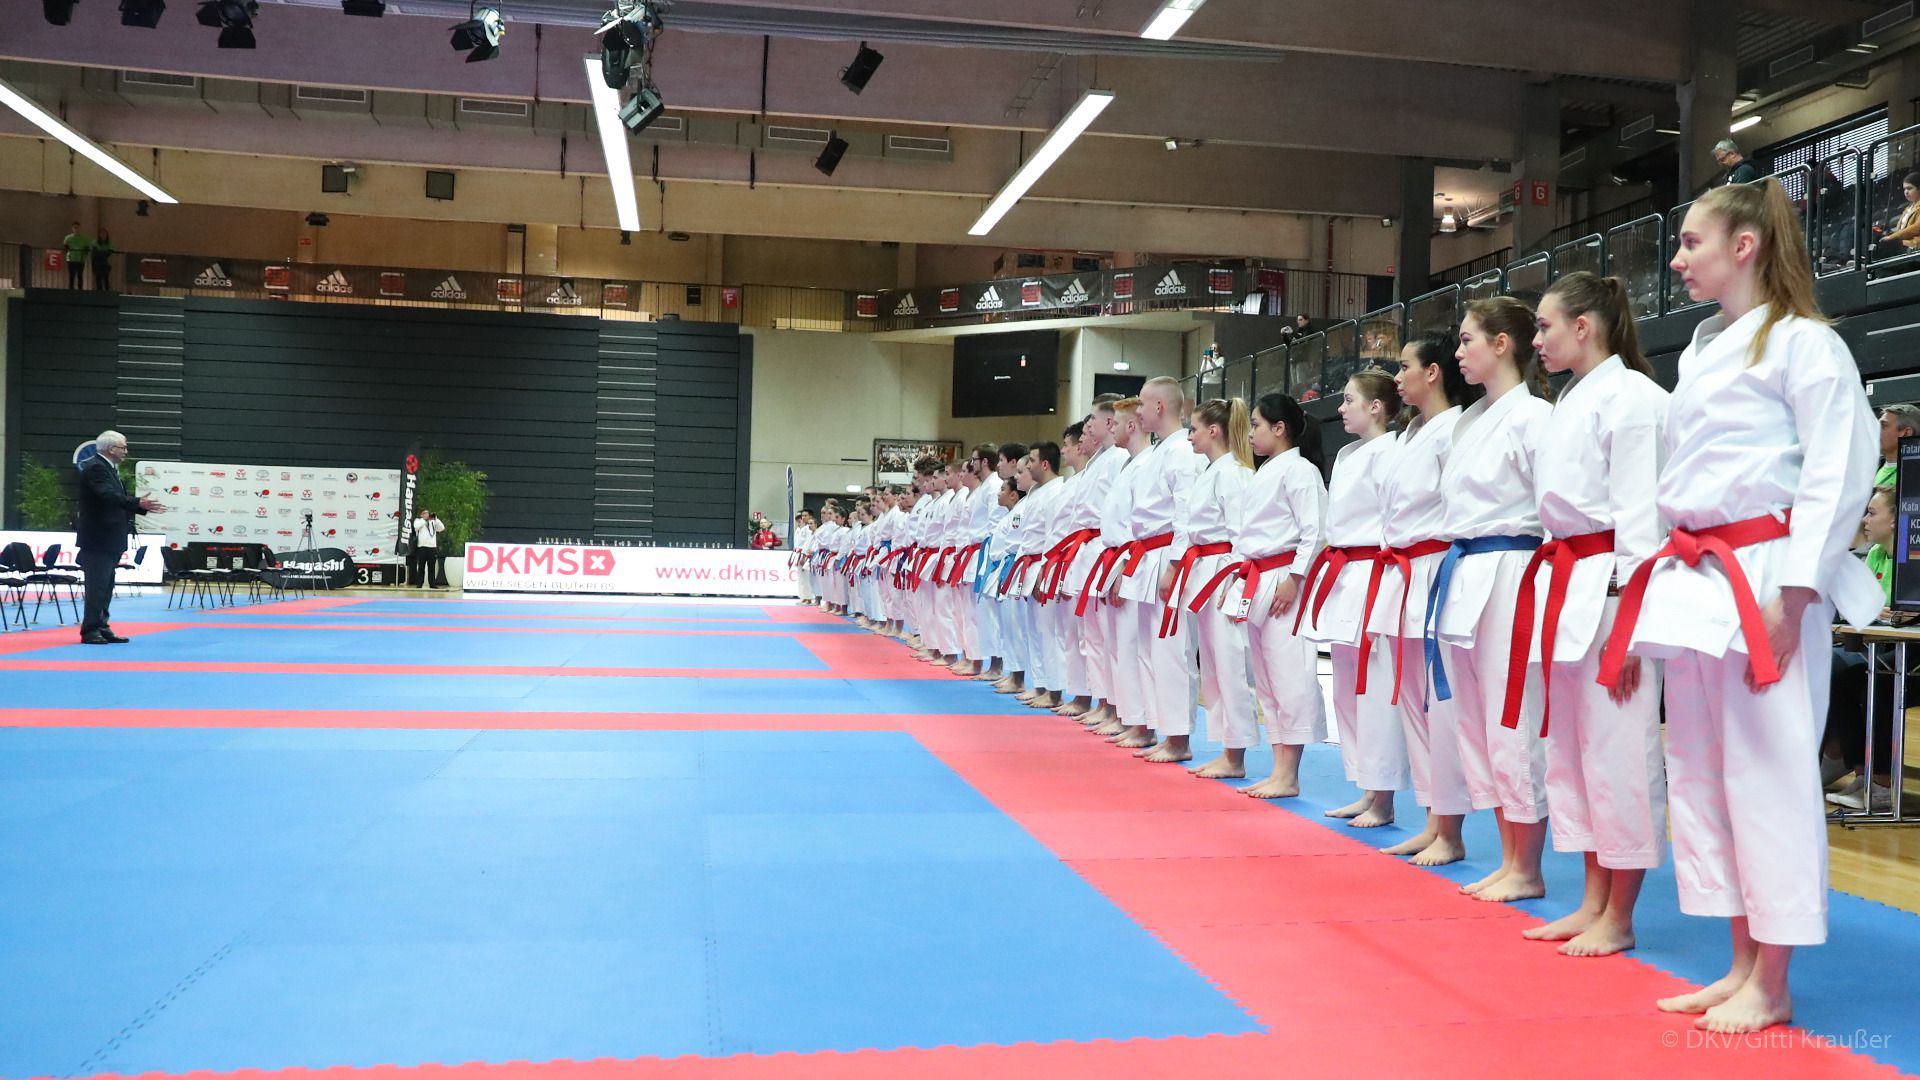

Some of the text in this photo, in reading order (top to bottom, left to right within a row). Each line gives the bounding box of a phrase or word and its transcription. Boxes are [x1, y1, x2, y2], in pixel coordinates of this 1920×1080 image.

[1536, 186, 1545, 200] G
[50, 254, 57, 266] E
[194, 277, 233, 287] adidas
[316, 282, 353, 293] adidas
[430, 288, 466, 299] adidas
[1154, 284, 1186, 295] adidas
[546, 295, 582, 305] adidas
[726, 293, 734, 304] F
[1060, 293, 1089, 304] adidas
[975, 299, 1003, 310] adidas
[893, 306, 919, 316] adidas
[1901, 501, 1919, 512] Kata
[282, 558, 347, 573] Hayashi
[467, 545, 580, 575] DKMS
[357, 567, 370, 584] 3
